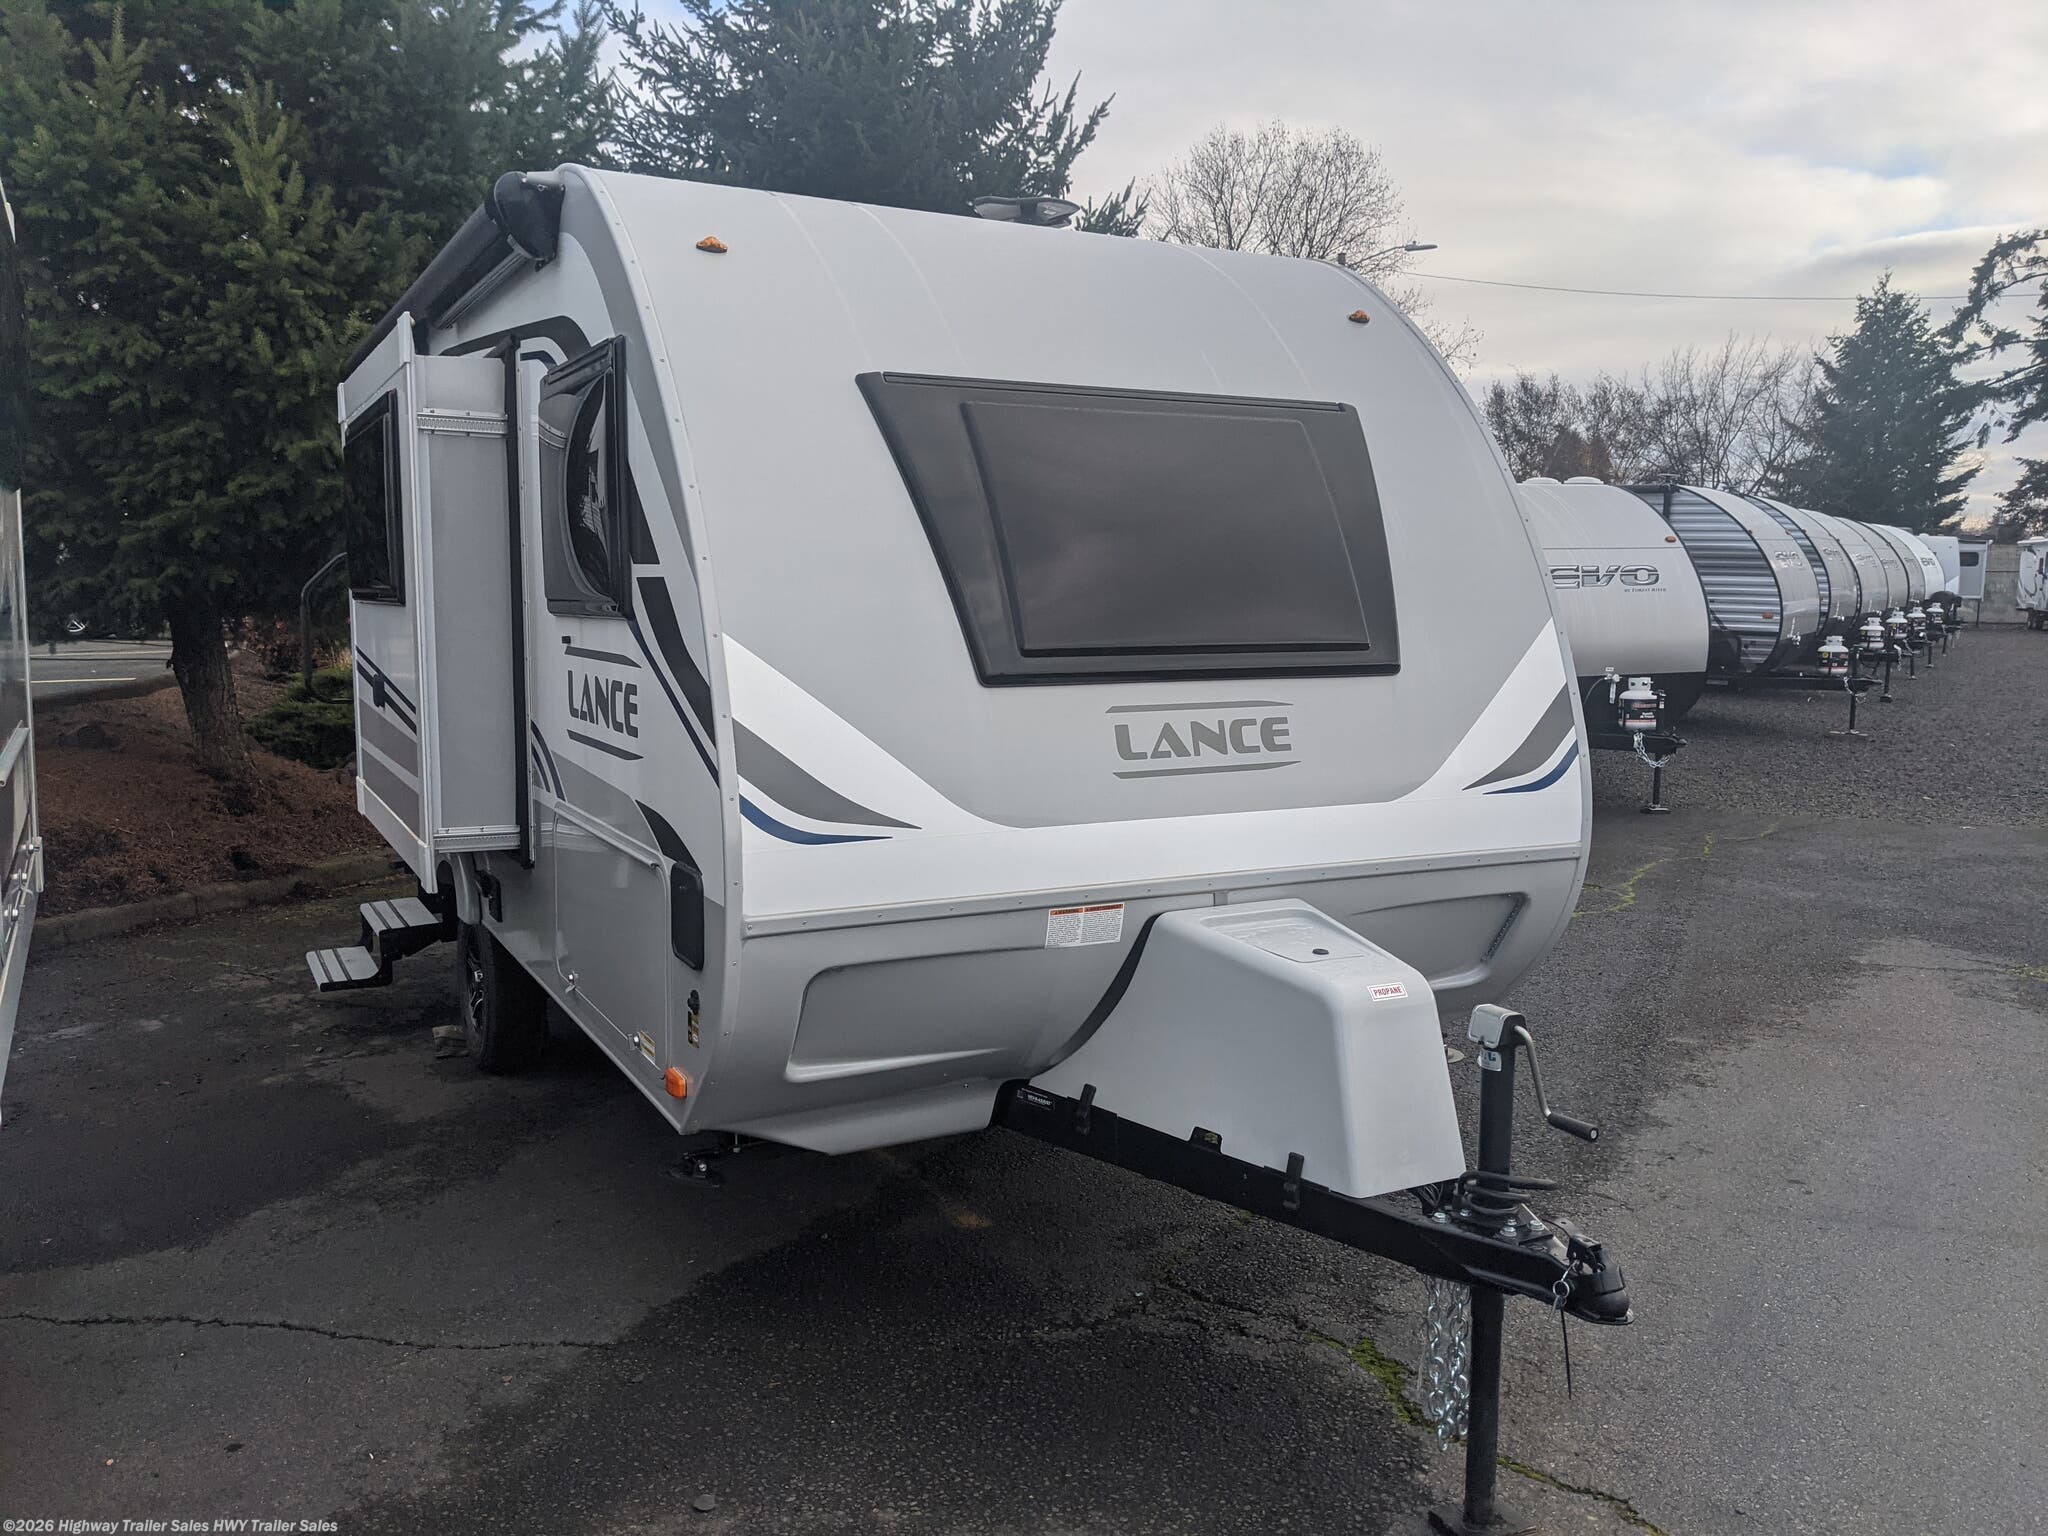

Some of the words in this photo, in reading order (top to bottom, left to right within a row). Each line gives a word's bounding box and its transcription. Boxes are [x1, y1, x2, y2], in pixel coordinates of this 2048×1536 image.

[1548, 564, 1659, 589] EVO
[567, 670, 639, 739] LANCE
[1114, 716, 1293, 761] LANCE
[1373, 986, 1403, 997] PROPANE
